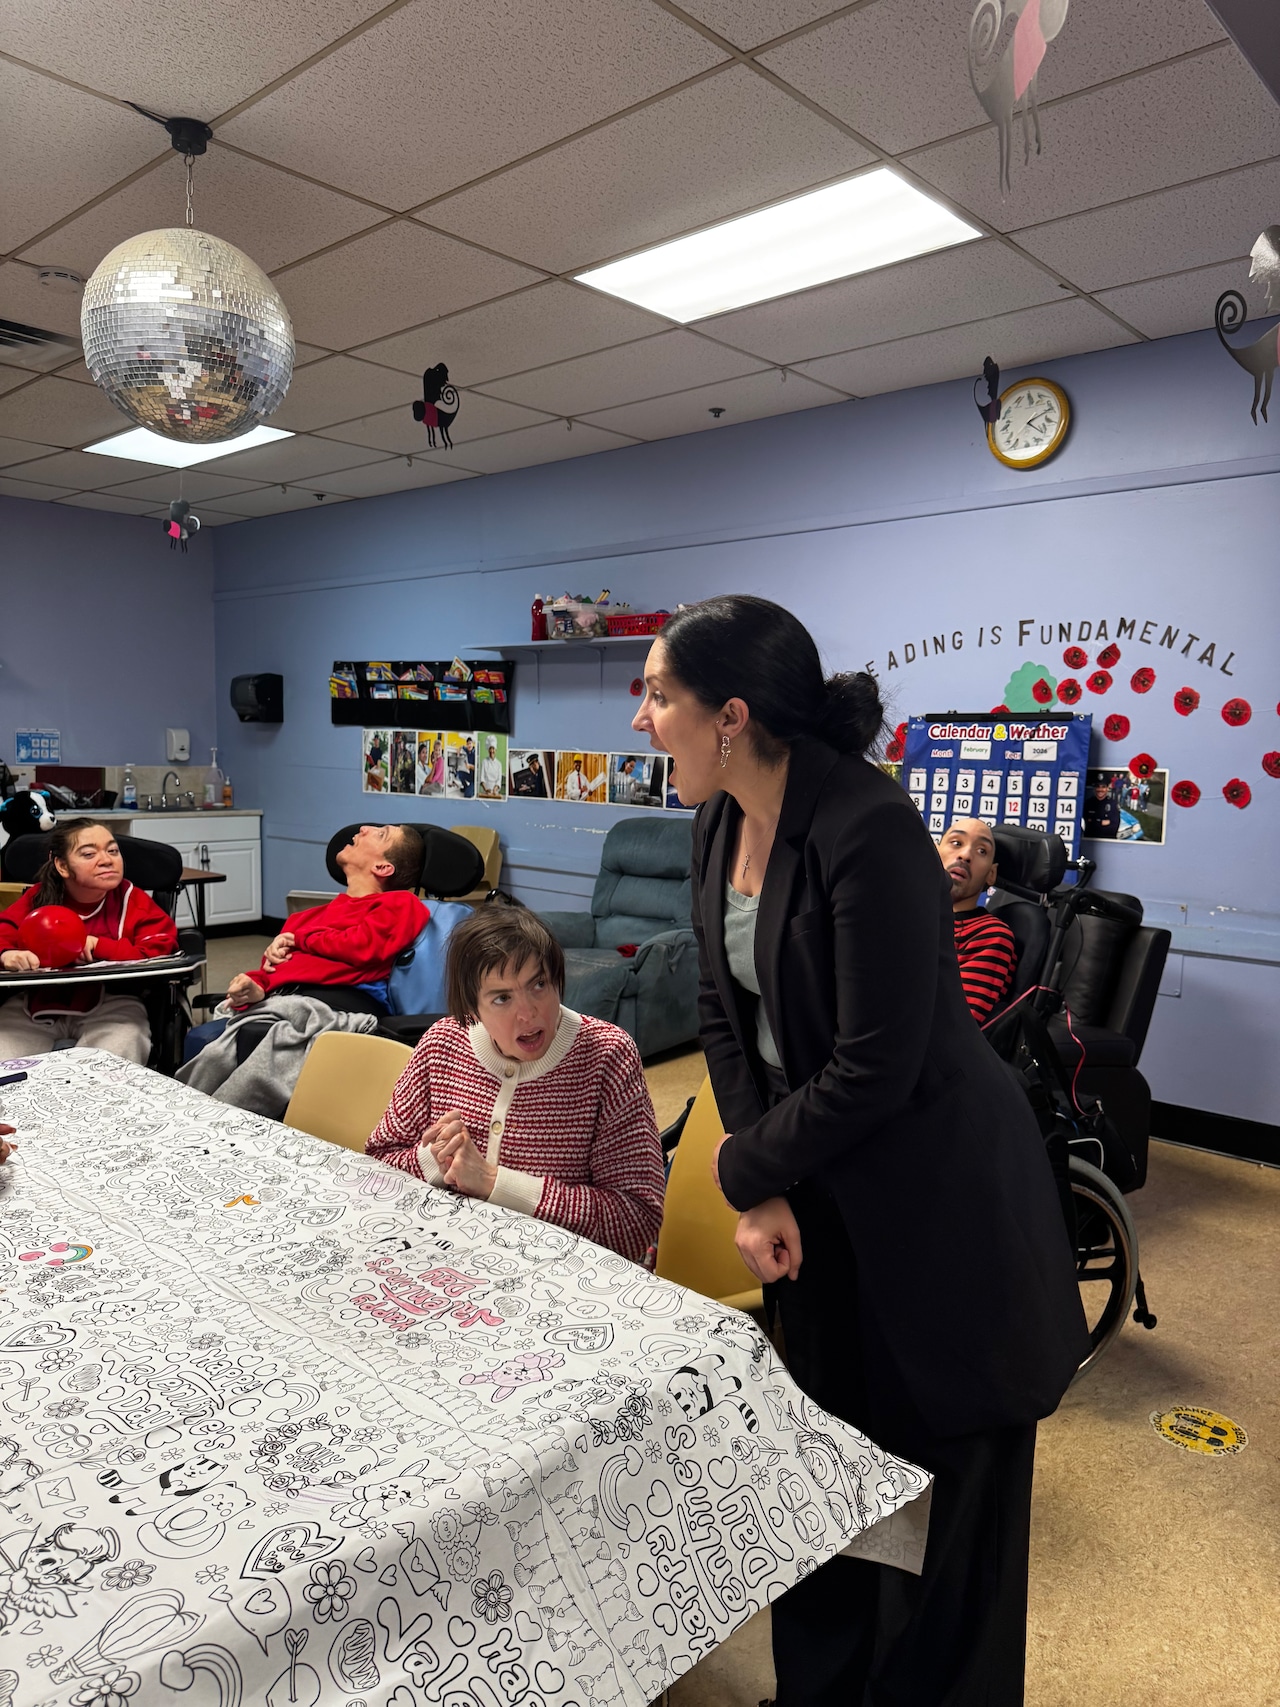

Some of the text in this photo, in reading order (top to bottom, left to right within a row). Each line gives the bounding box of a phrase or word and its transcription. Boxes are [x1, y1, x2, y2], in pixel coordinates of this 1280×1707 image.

[865, 631, 963, 678] EADING
[978, 625, 1002, 648] IS
[929, 723, 1068, 741] Calendar & Weather
[938, 777, 944, 787] 2
[962, 778, 969, 788] 3
[987, 779, 994, 789] 4
[1012, 780, 1018, 791] 5
[1036, 781, 1044, 791] 6
[1064, 781, 1072, 792] 7
[914, 797, 1073, 813] 8 9 10 11 12 13 14
[932, 818, 941, 828] 16
[1059, 825, 1071, 836] 21
[85, 1389, 175, 1436] Day
[717, 1484, 795, 1589] Day
